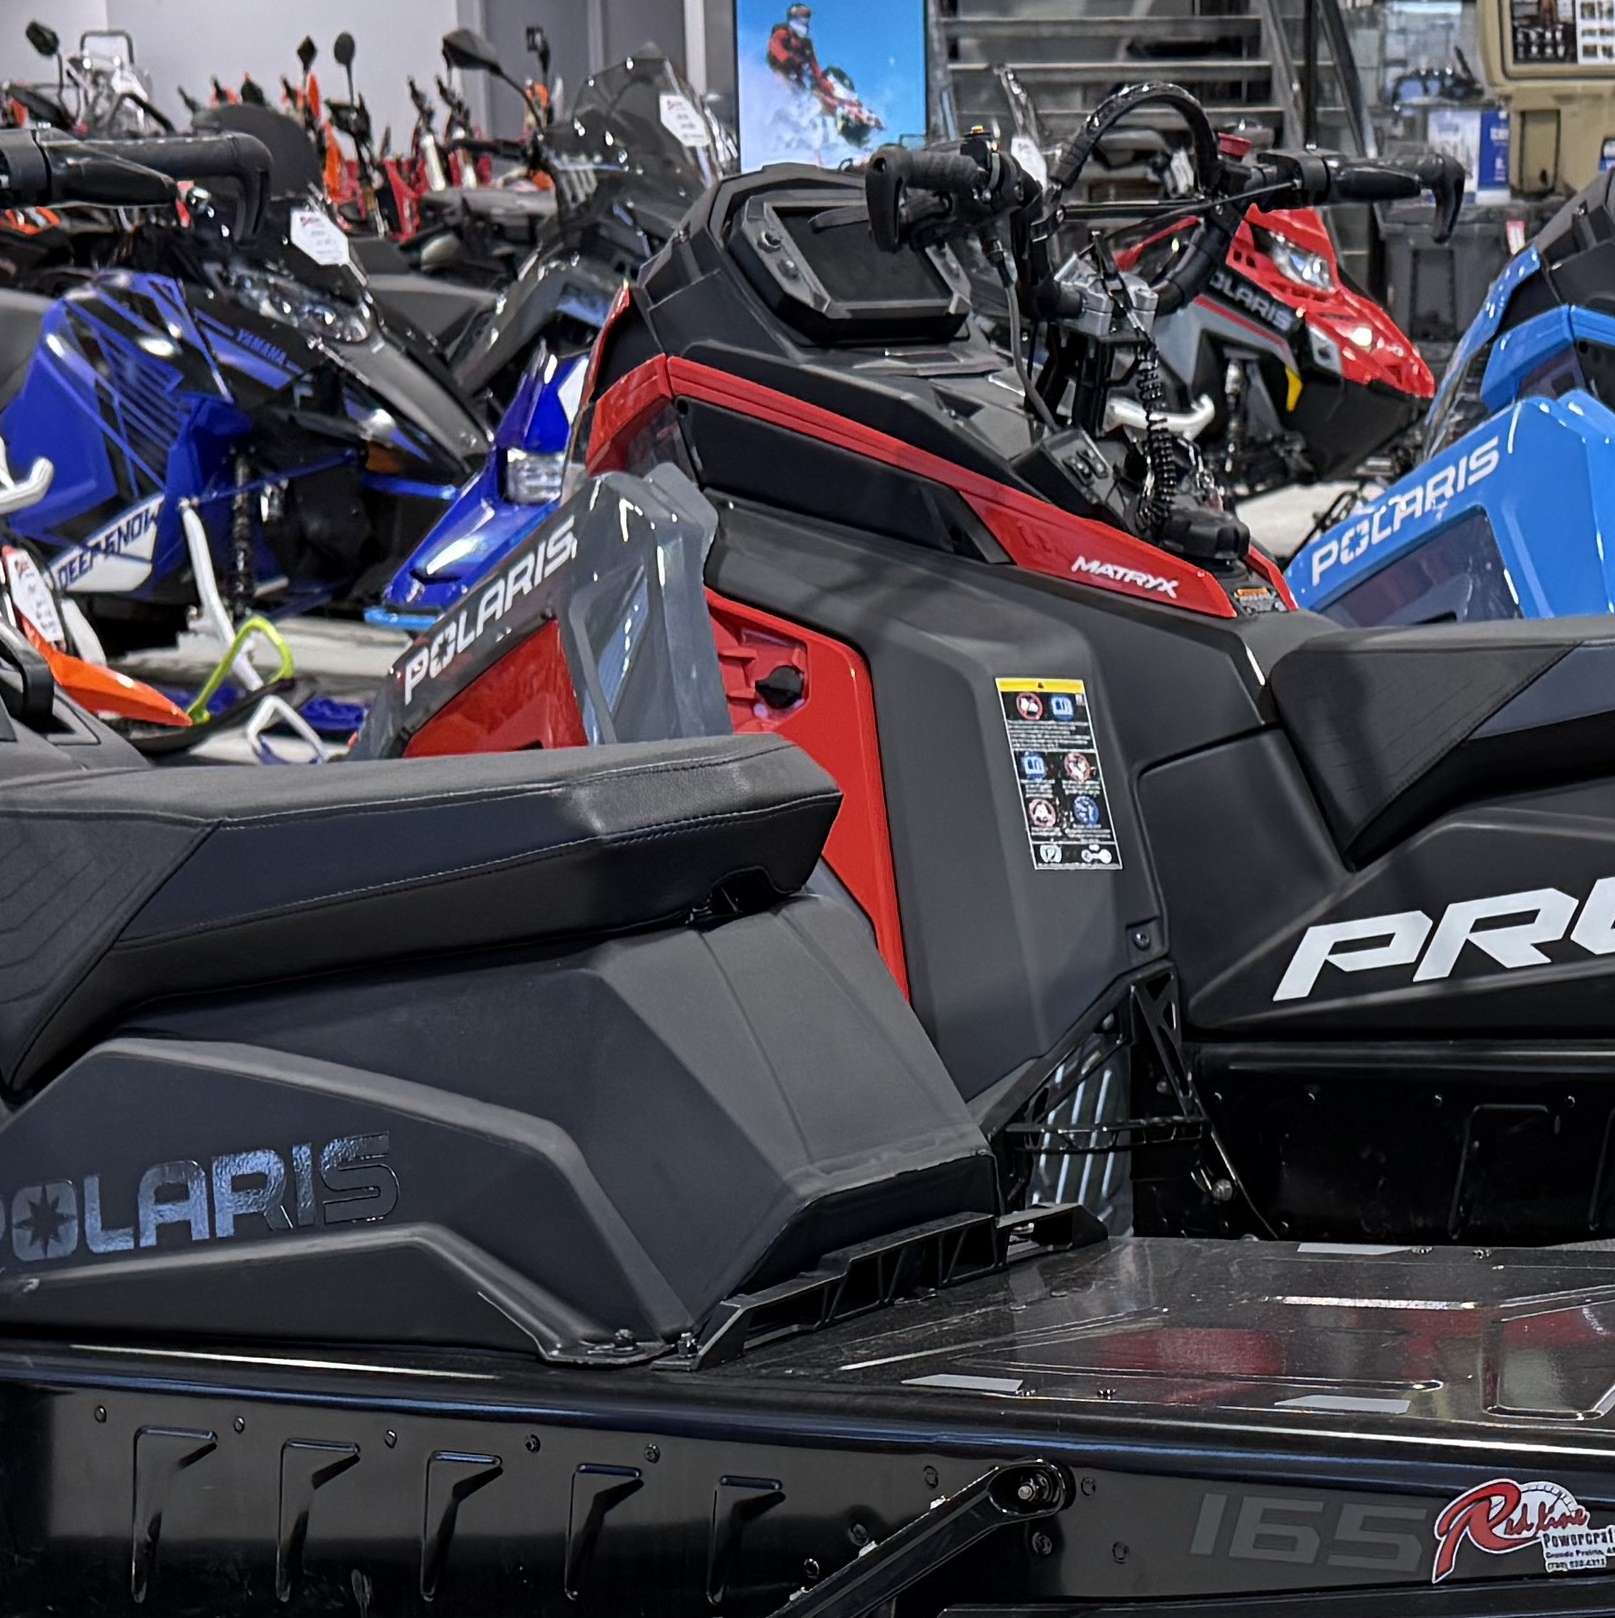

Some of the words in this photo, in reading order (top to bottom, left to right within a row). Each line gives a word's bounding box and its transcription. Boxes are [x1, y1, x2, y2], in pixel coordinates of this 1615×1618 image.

[1209, 269, 1294, 332] OLARIS
[237, 328, 288, 366] YAMAHA
[1311, 435, 1500, 587] POLARIS
[404, 514, 576, 707] POLARIS
[1070, 555, 1180, 600] MATRYX
[1189, 1492, 1428, 1568] 165
